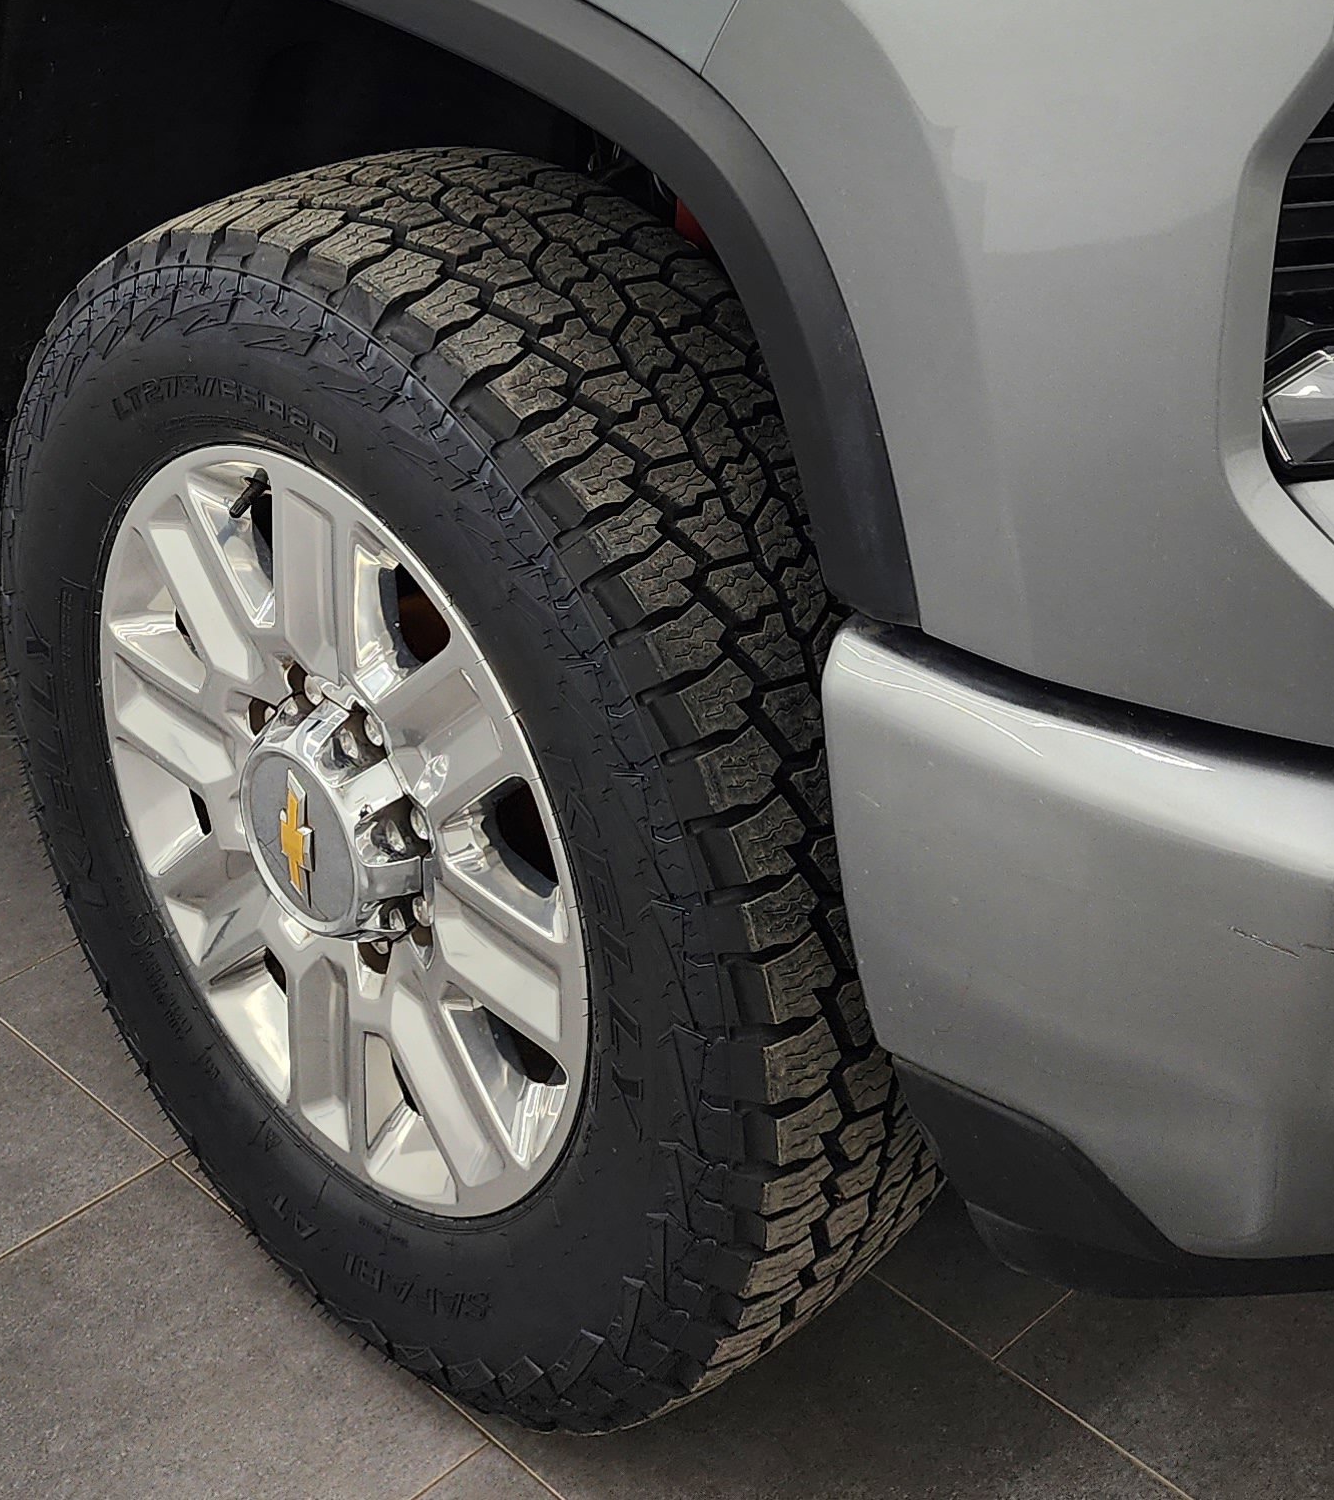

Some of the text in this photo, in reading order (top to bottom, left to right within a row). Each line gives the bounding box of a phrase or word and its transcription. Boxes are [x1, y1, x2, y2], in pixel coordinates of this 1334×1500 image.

[22, 606, 109, 909] KELLY
[563, 784, 647, 1145] KELLY
[341, 1248, 495, 1324] SAFARI
